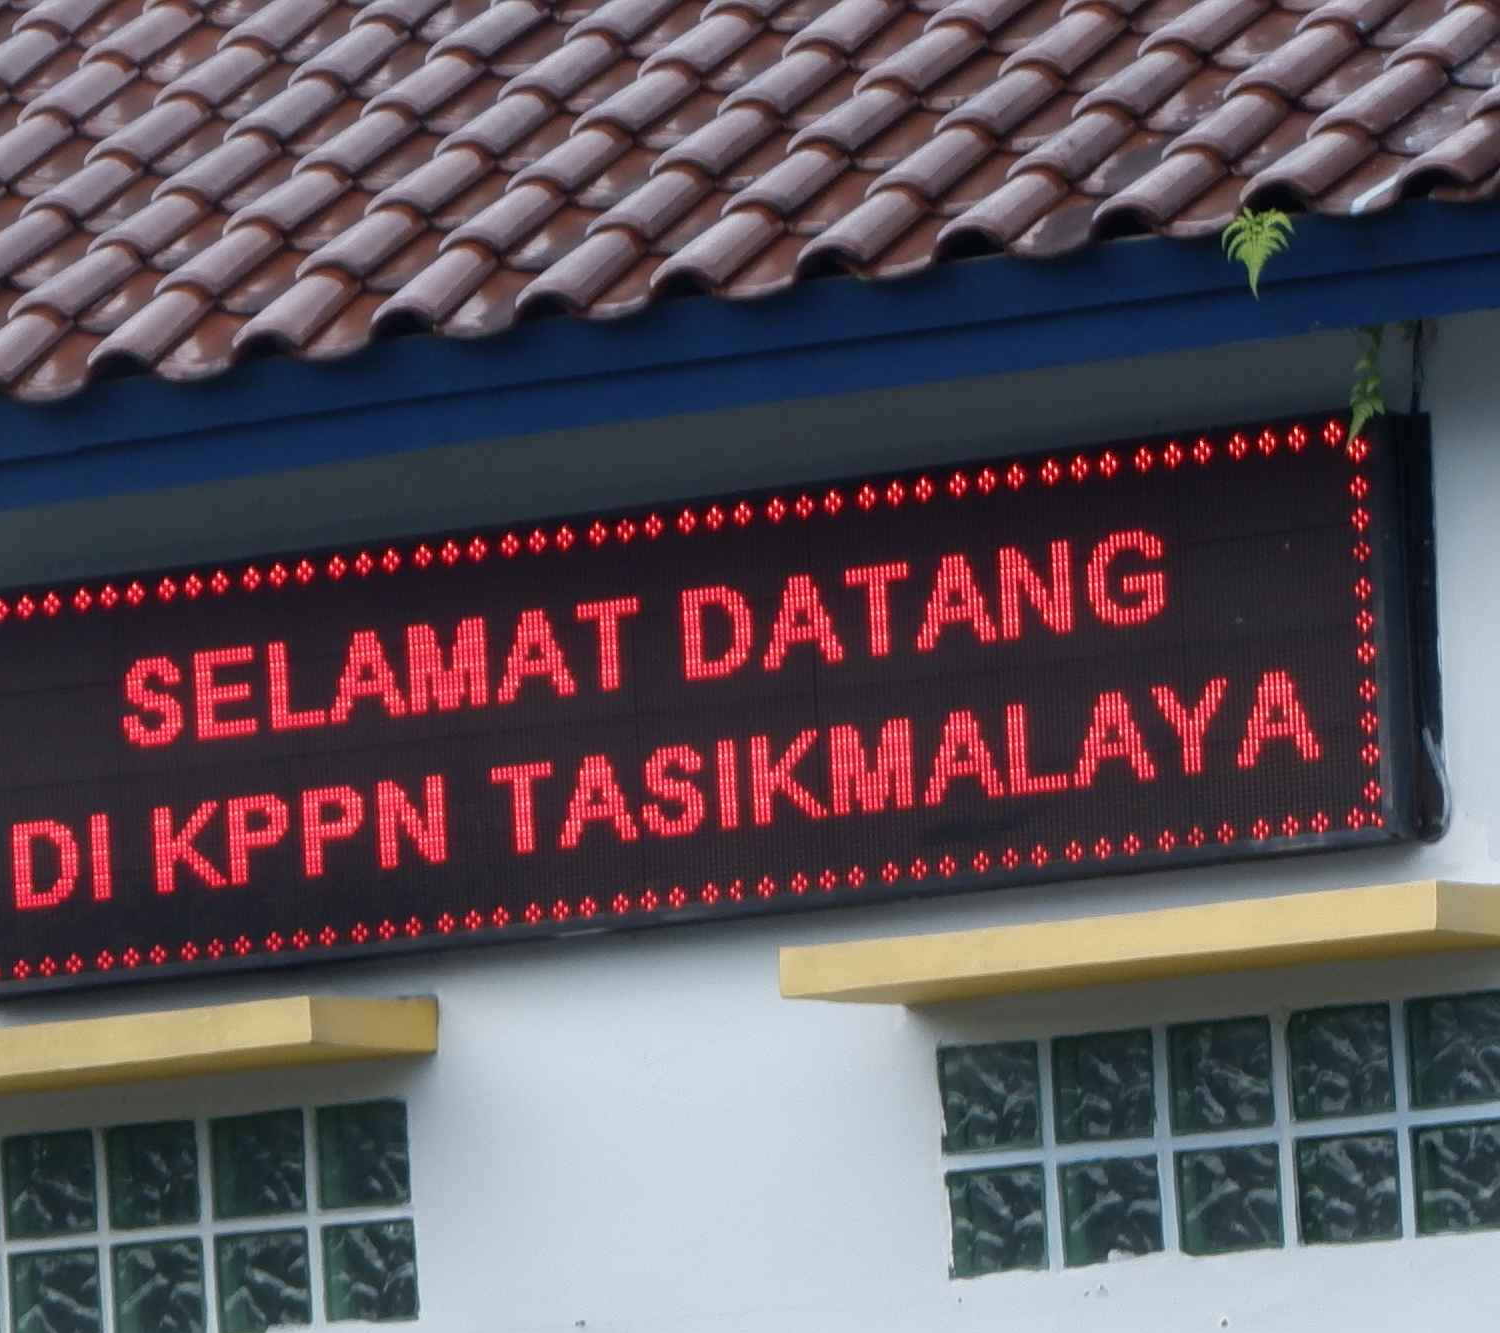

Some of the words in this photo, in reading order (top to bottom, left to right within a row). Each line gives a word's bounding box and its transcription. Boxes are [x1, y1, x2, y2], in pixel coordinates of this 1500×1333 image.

[122, 597, 642, 748] SELAMAT
[681, 530, 1167, 681] DATANG
[11, 813, 114, 911] DI
[153, 775, 448, 895] KPPN
[490, 671, 1322, 854] TASIKMALAYA
